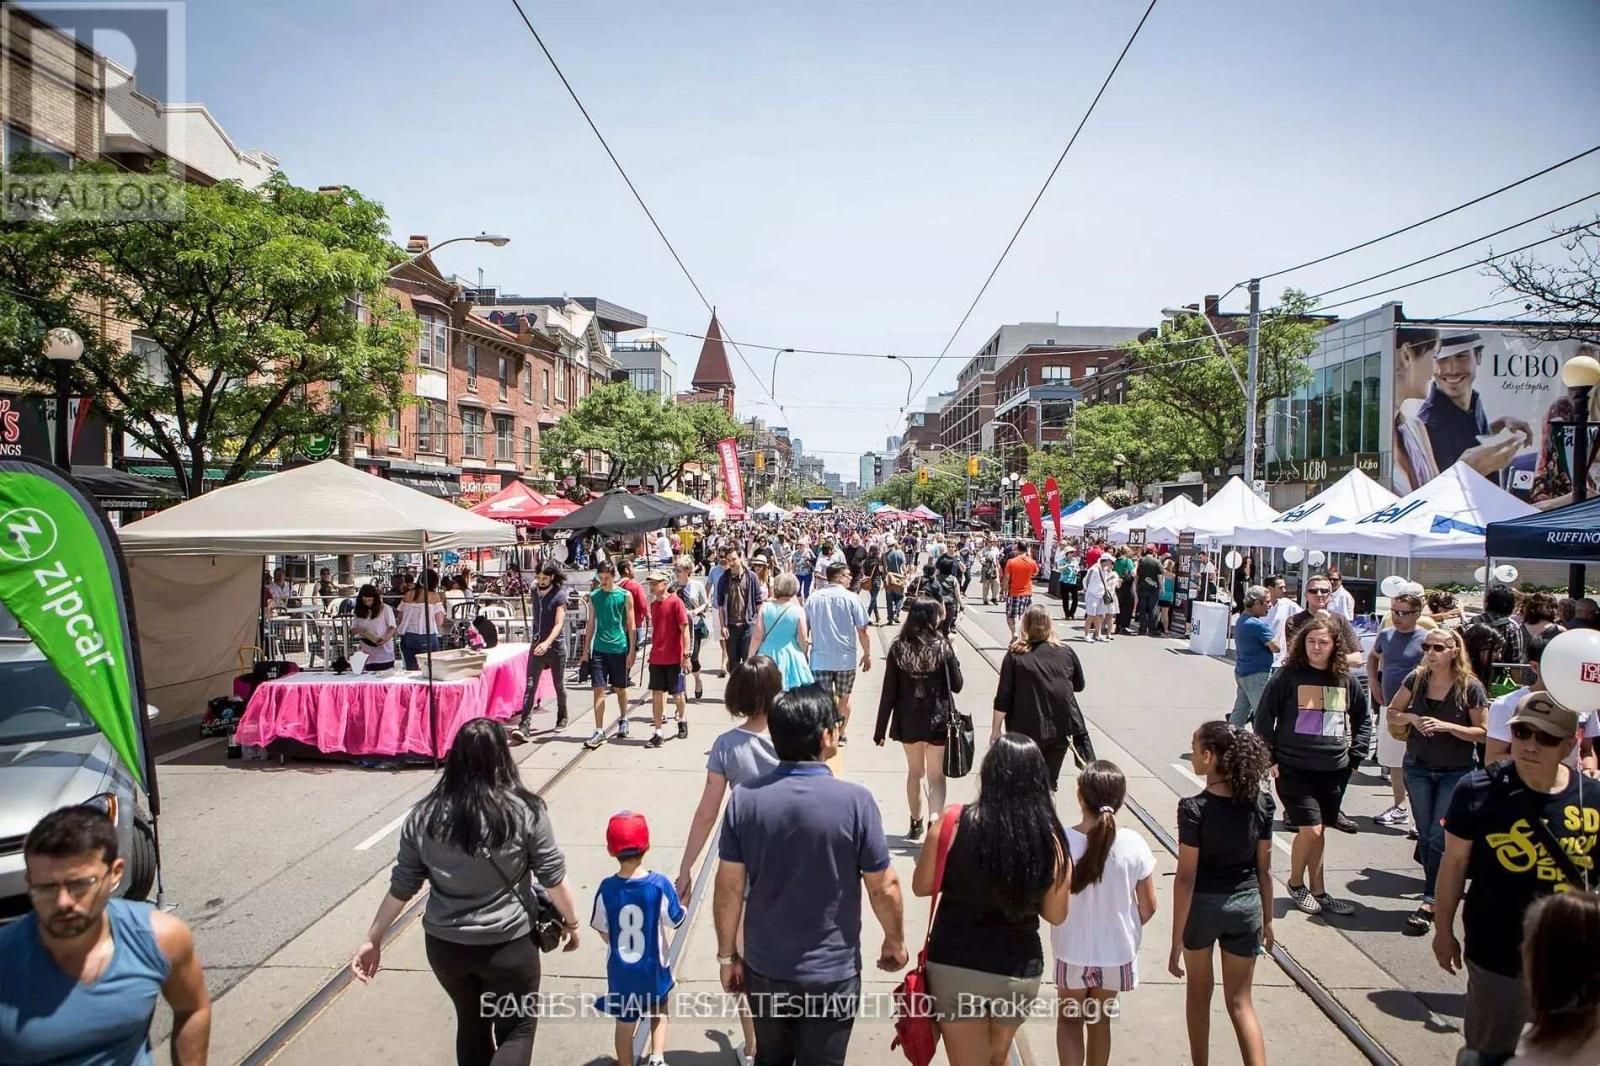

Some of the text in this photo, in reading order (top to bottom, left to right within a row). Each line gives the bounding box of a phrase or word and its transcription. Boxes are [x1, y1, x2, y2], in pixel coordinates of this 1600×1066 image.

[1493, 354, 1559, 378] LCBO
[1303, 461, 1327, 480] LCBO
[1359, 460, 1378, 470] LCBO
[1547, 531, 1600, 544] RUFFINO
[34, 560, 115, 667] zipcar
[618, 904, 646, 964] 8
